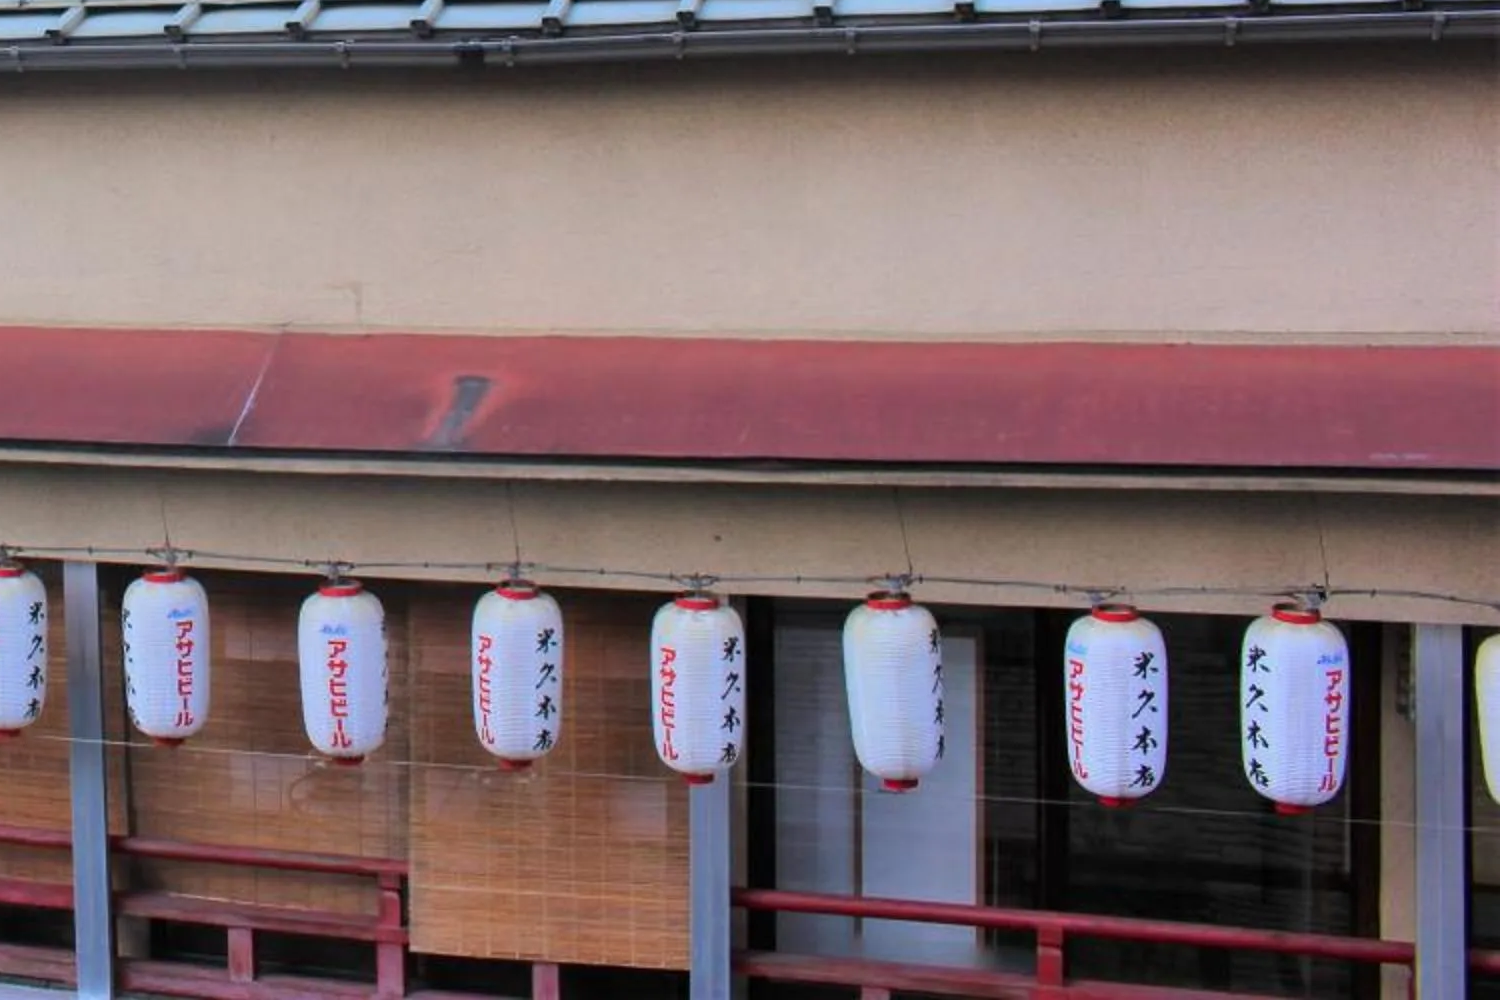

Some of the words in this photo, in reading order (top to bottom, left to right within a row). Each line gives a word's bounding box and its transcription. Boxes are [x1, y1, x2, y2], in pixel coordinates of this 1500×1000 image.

[175, 620, 195, 728] アサヒビール
[327, 639, 353, 749] アサヒビール
[477, 635, 495, 745] アサヒビール
[659, 646, 679, 761] アサヒビール
[1069, 659, 1089, 780] アサヒビール
[1128, 651, 1159, 788] 米久本店
[1245, 645, 1270, 789] 米久本店
[1317, 668, 1343, 793] アサヒビール
